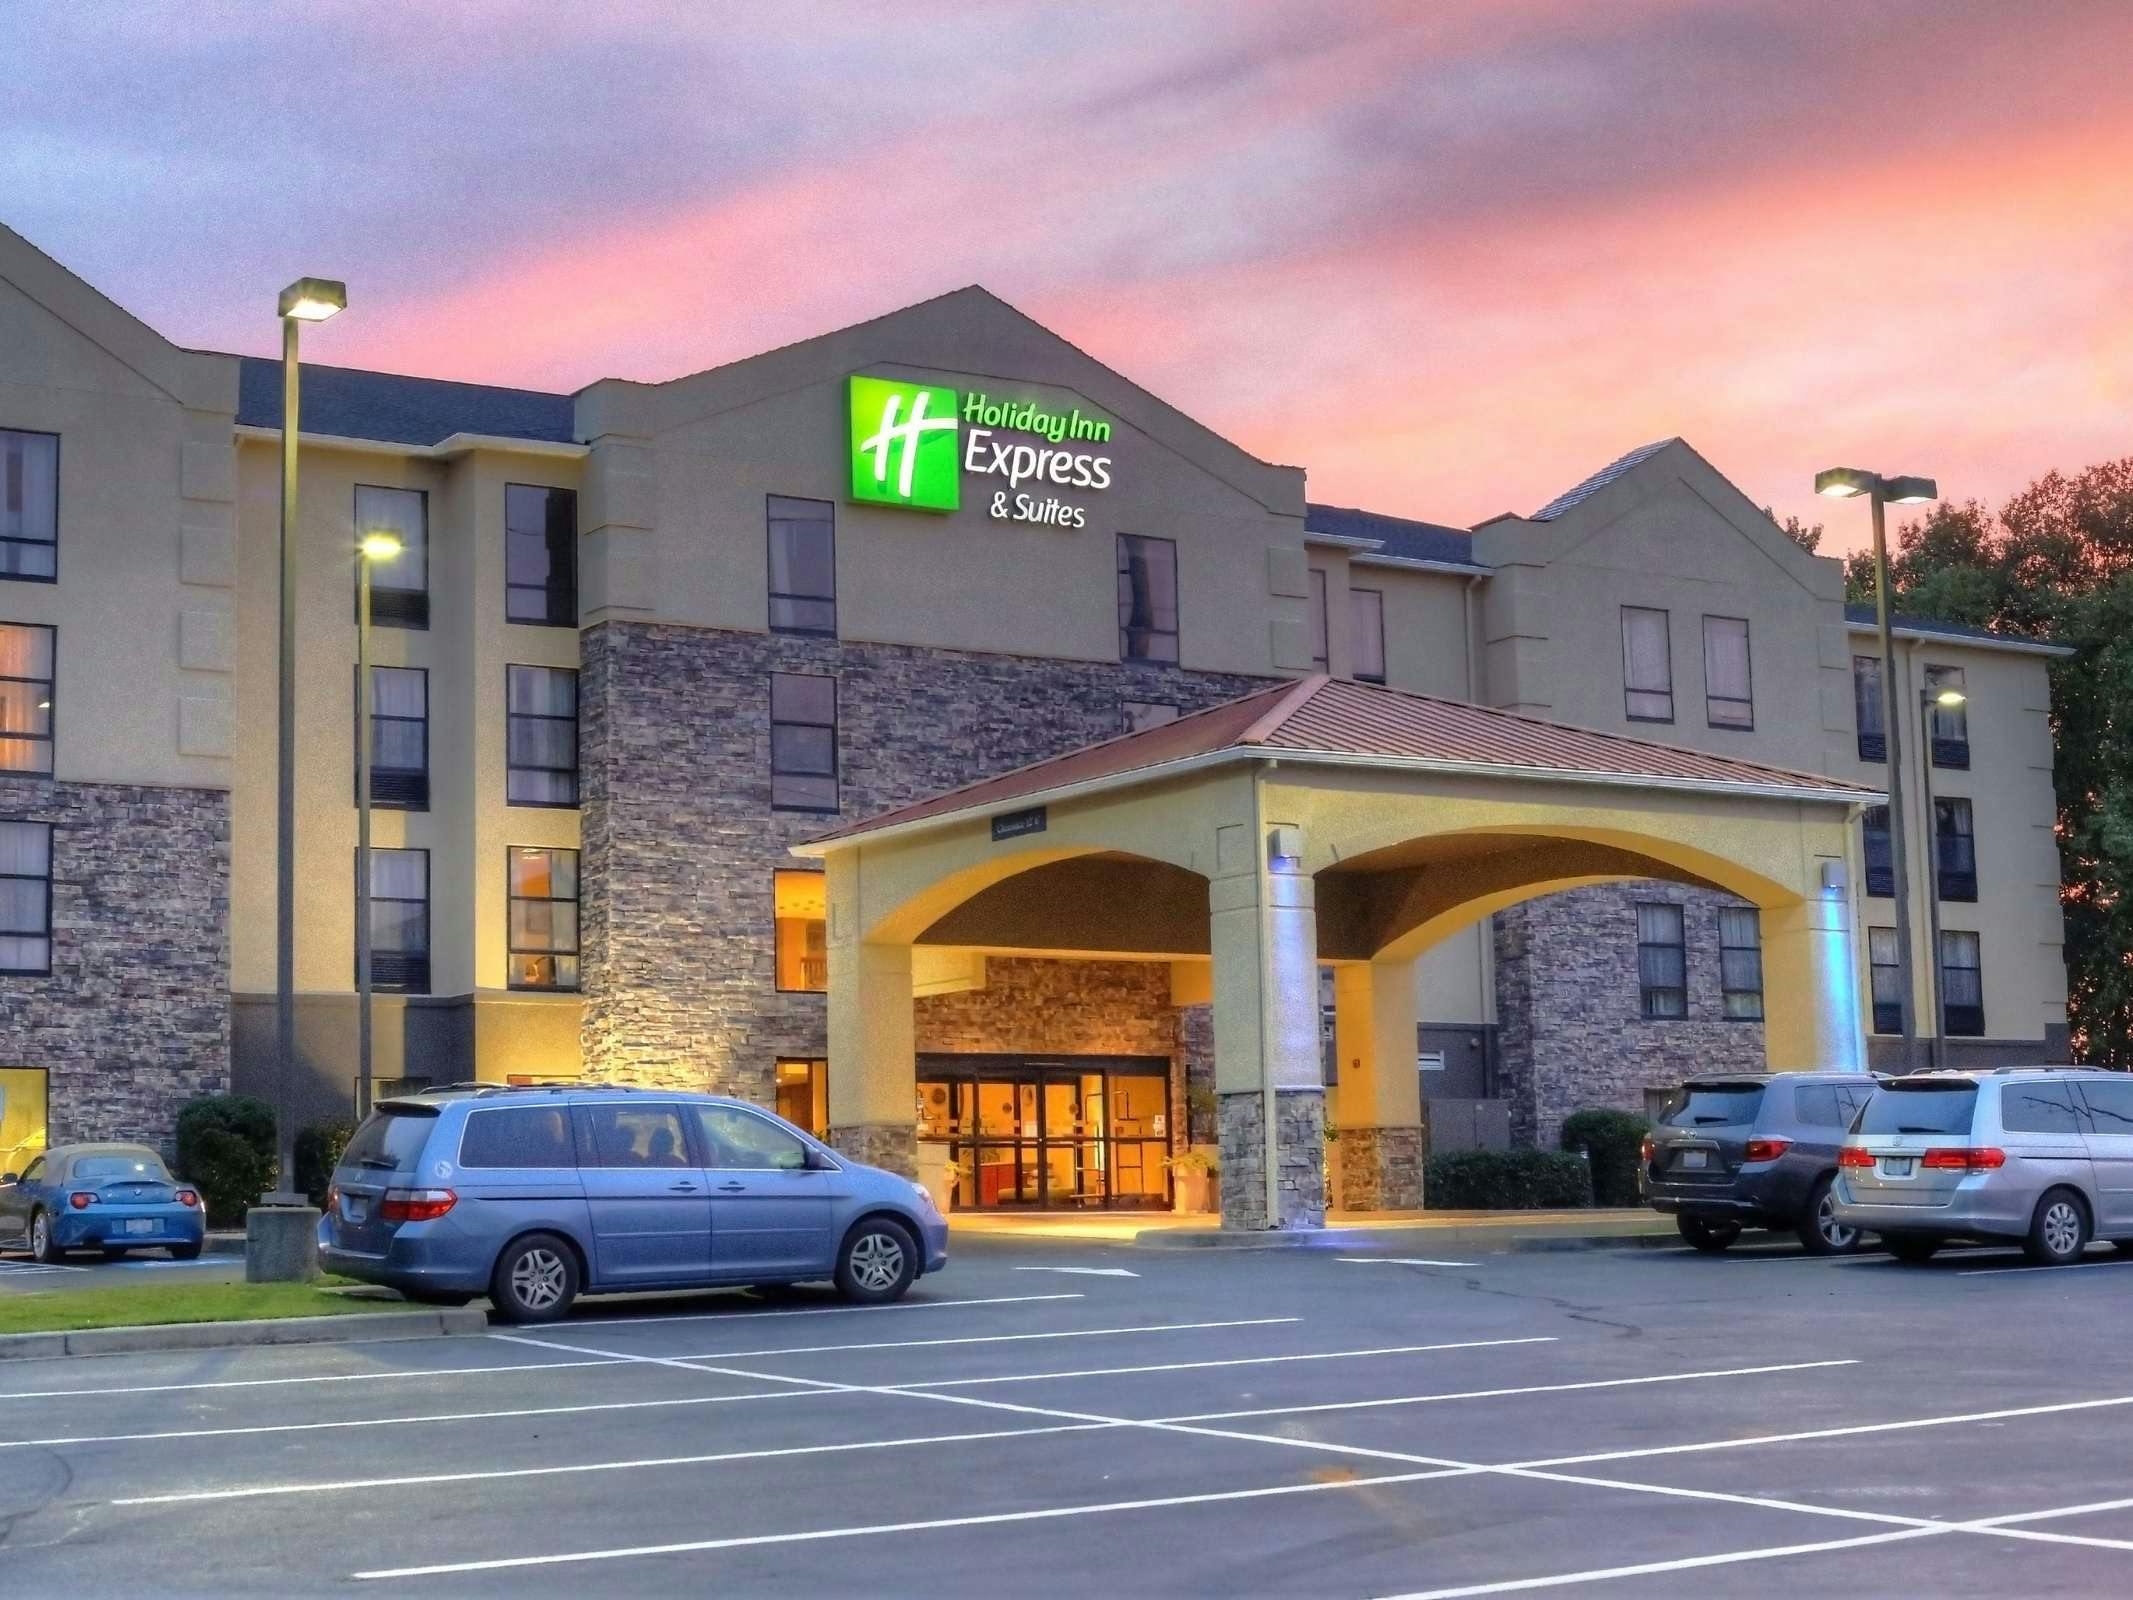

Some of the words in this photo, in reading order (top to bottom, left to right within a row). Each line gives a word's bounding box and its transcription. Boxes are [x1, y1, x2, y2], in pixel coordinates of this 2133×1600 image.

[964, 392, 1066, 443] Holiday
[1070, 410, 1111, 442] Inn
[964, 429, 1111, 489] Express
[991, 491, 1008, 518] &
[1013, 494, 1085, 528] Suites
